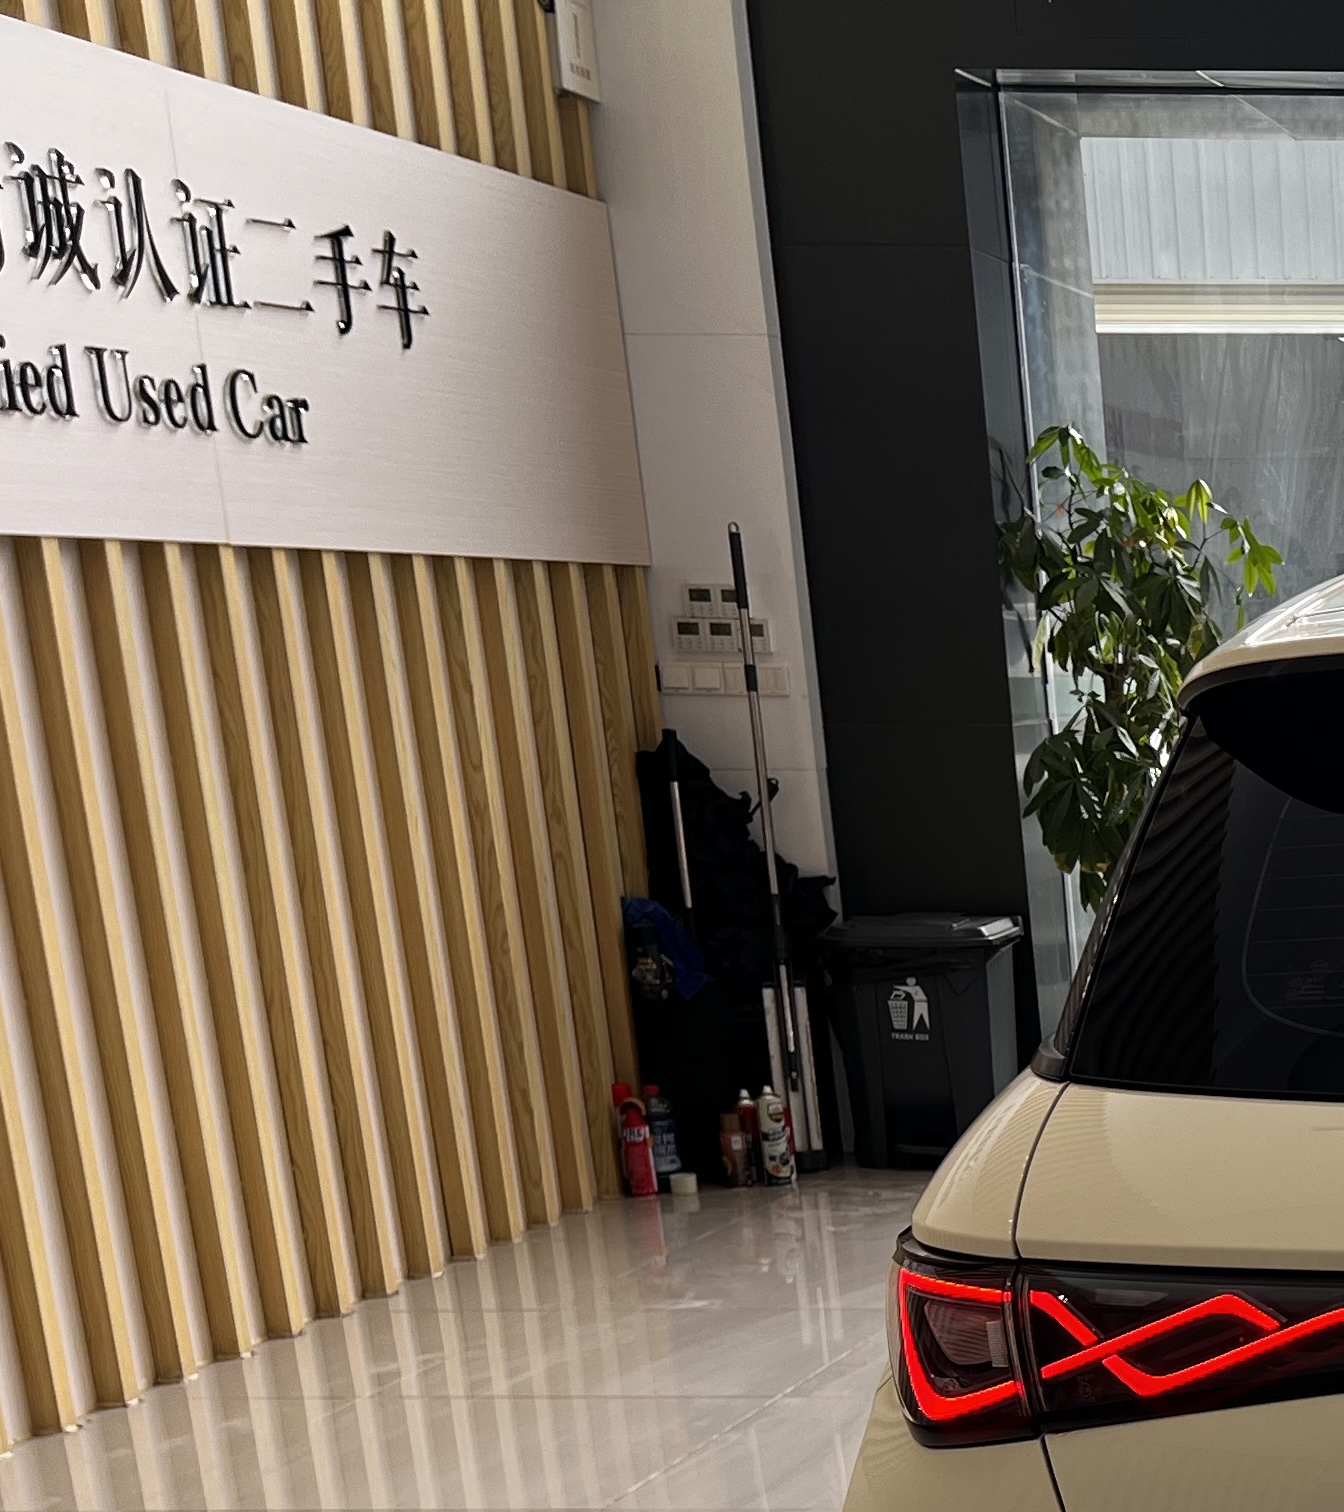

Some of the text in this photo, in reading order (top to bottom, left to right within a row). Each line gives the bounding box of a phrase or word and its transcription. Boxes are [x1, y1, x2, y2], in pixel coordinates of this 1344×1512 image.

[0, 142, 430, 350] 诚认证二手车
[84, 346, 218, 433] Used
[225, 369, 309, 444] Car
